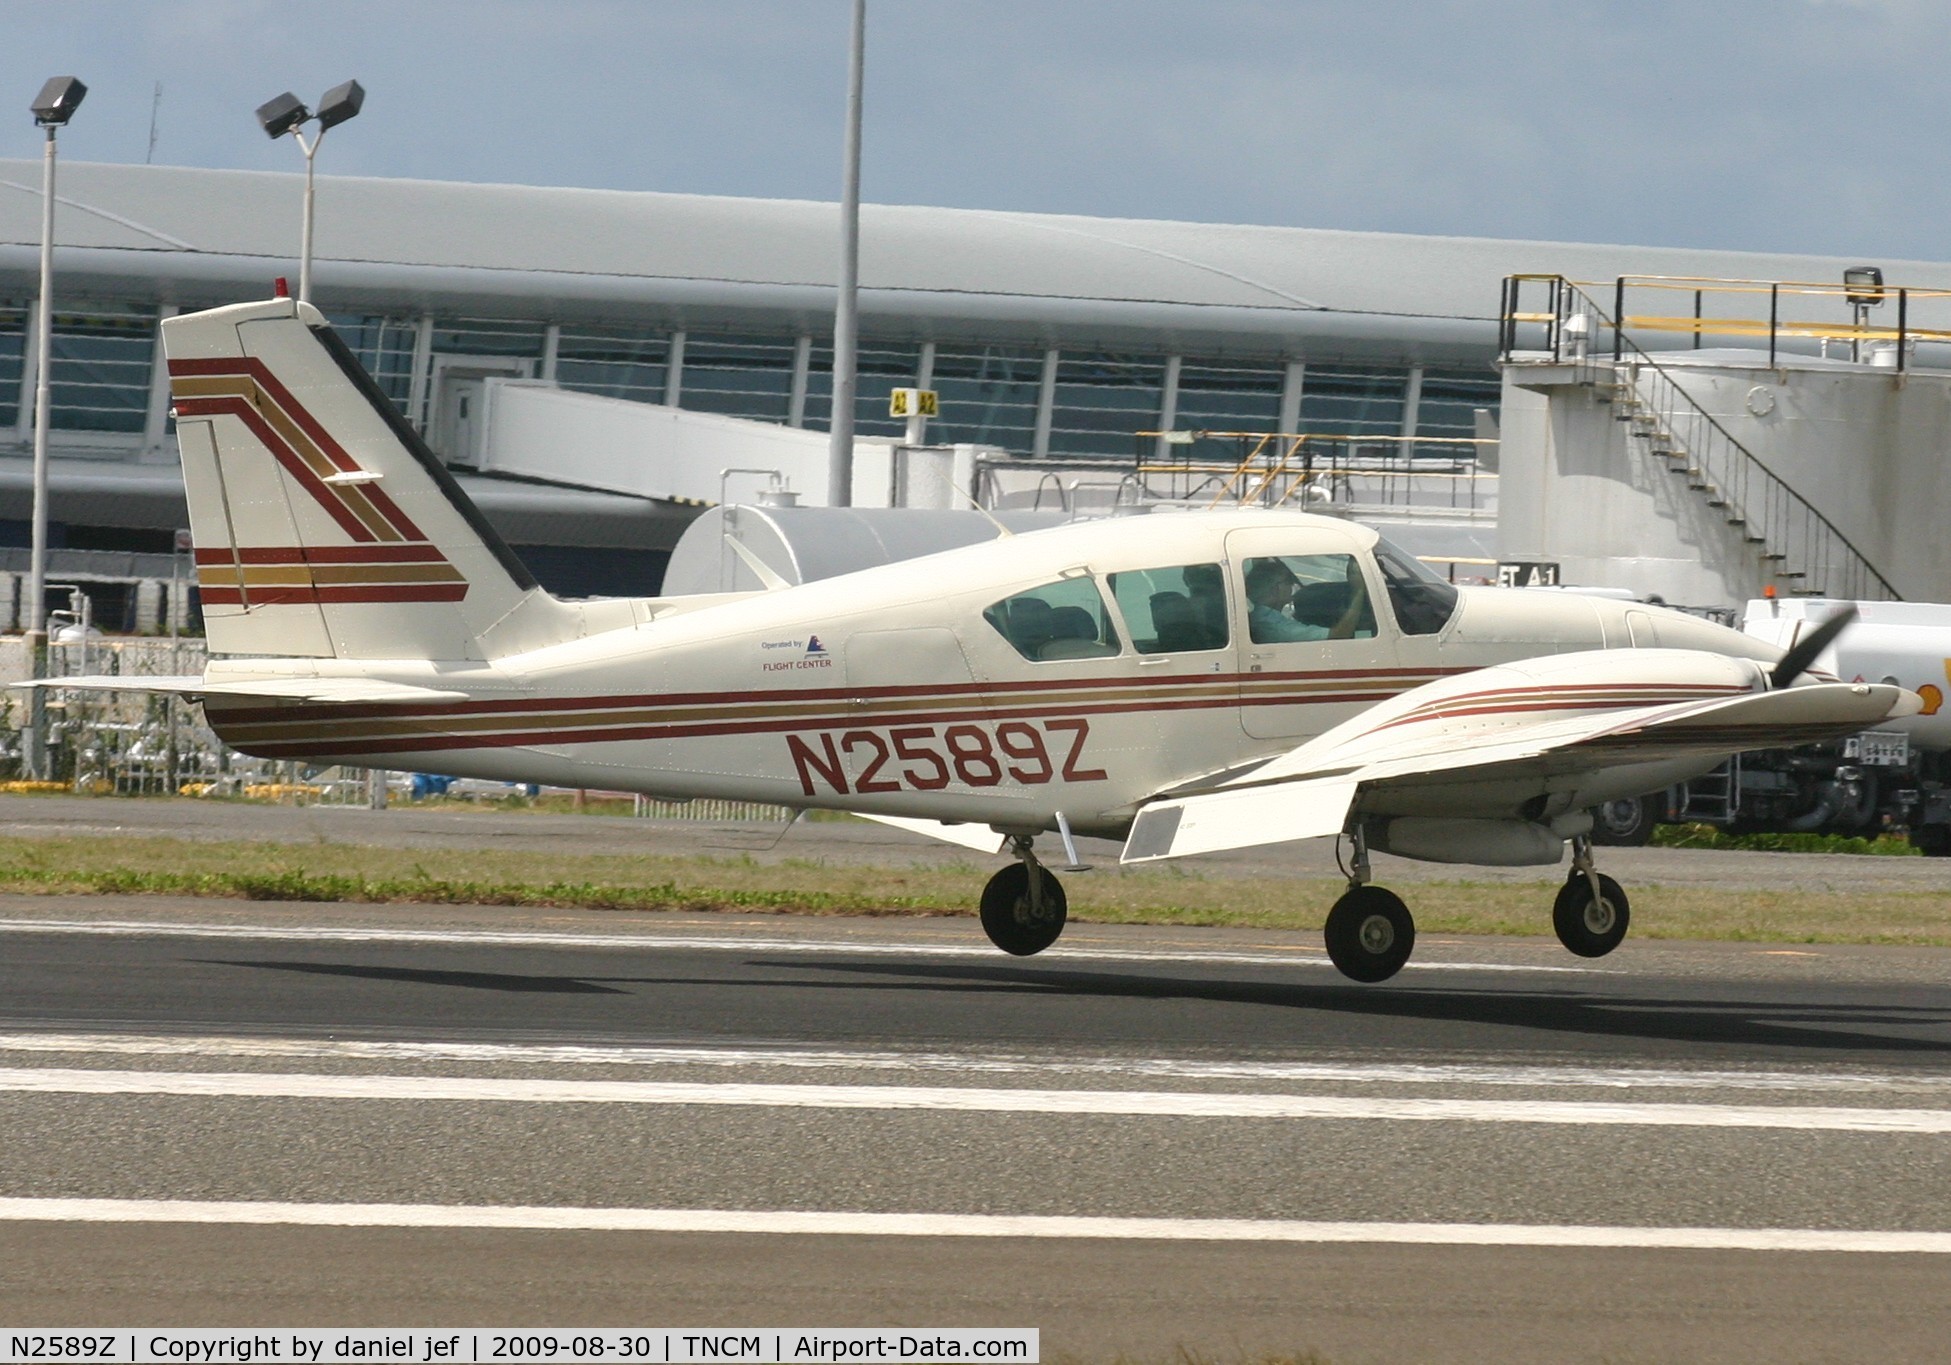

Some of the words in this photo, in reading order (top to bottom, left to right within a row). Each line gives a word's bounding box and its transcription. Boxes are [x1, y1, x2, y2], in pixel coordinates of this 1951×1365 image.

[1497, 565, 1520, 588] ET
[1526, 566, 1554, 586] A-1
[761, 641, 792, 650] Operated
[763, 662, 794, 672] FLIGHT
[796, 659, 832, 669] CENTER
[786, 718, 1108, 796] N2589Z
